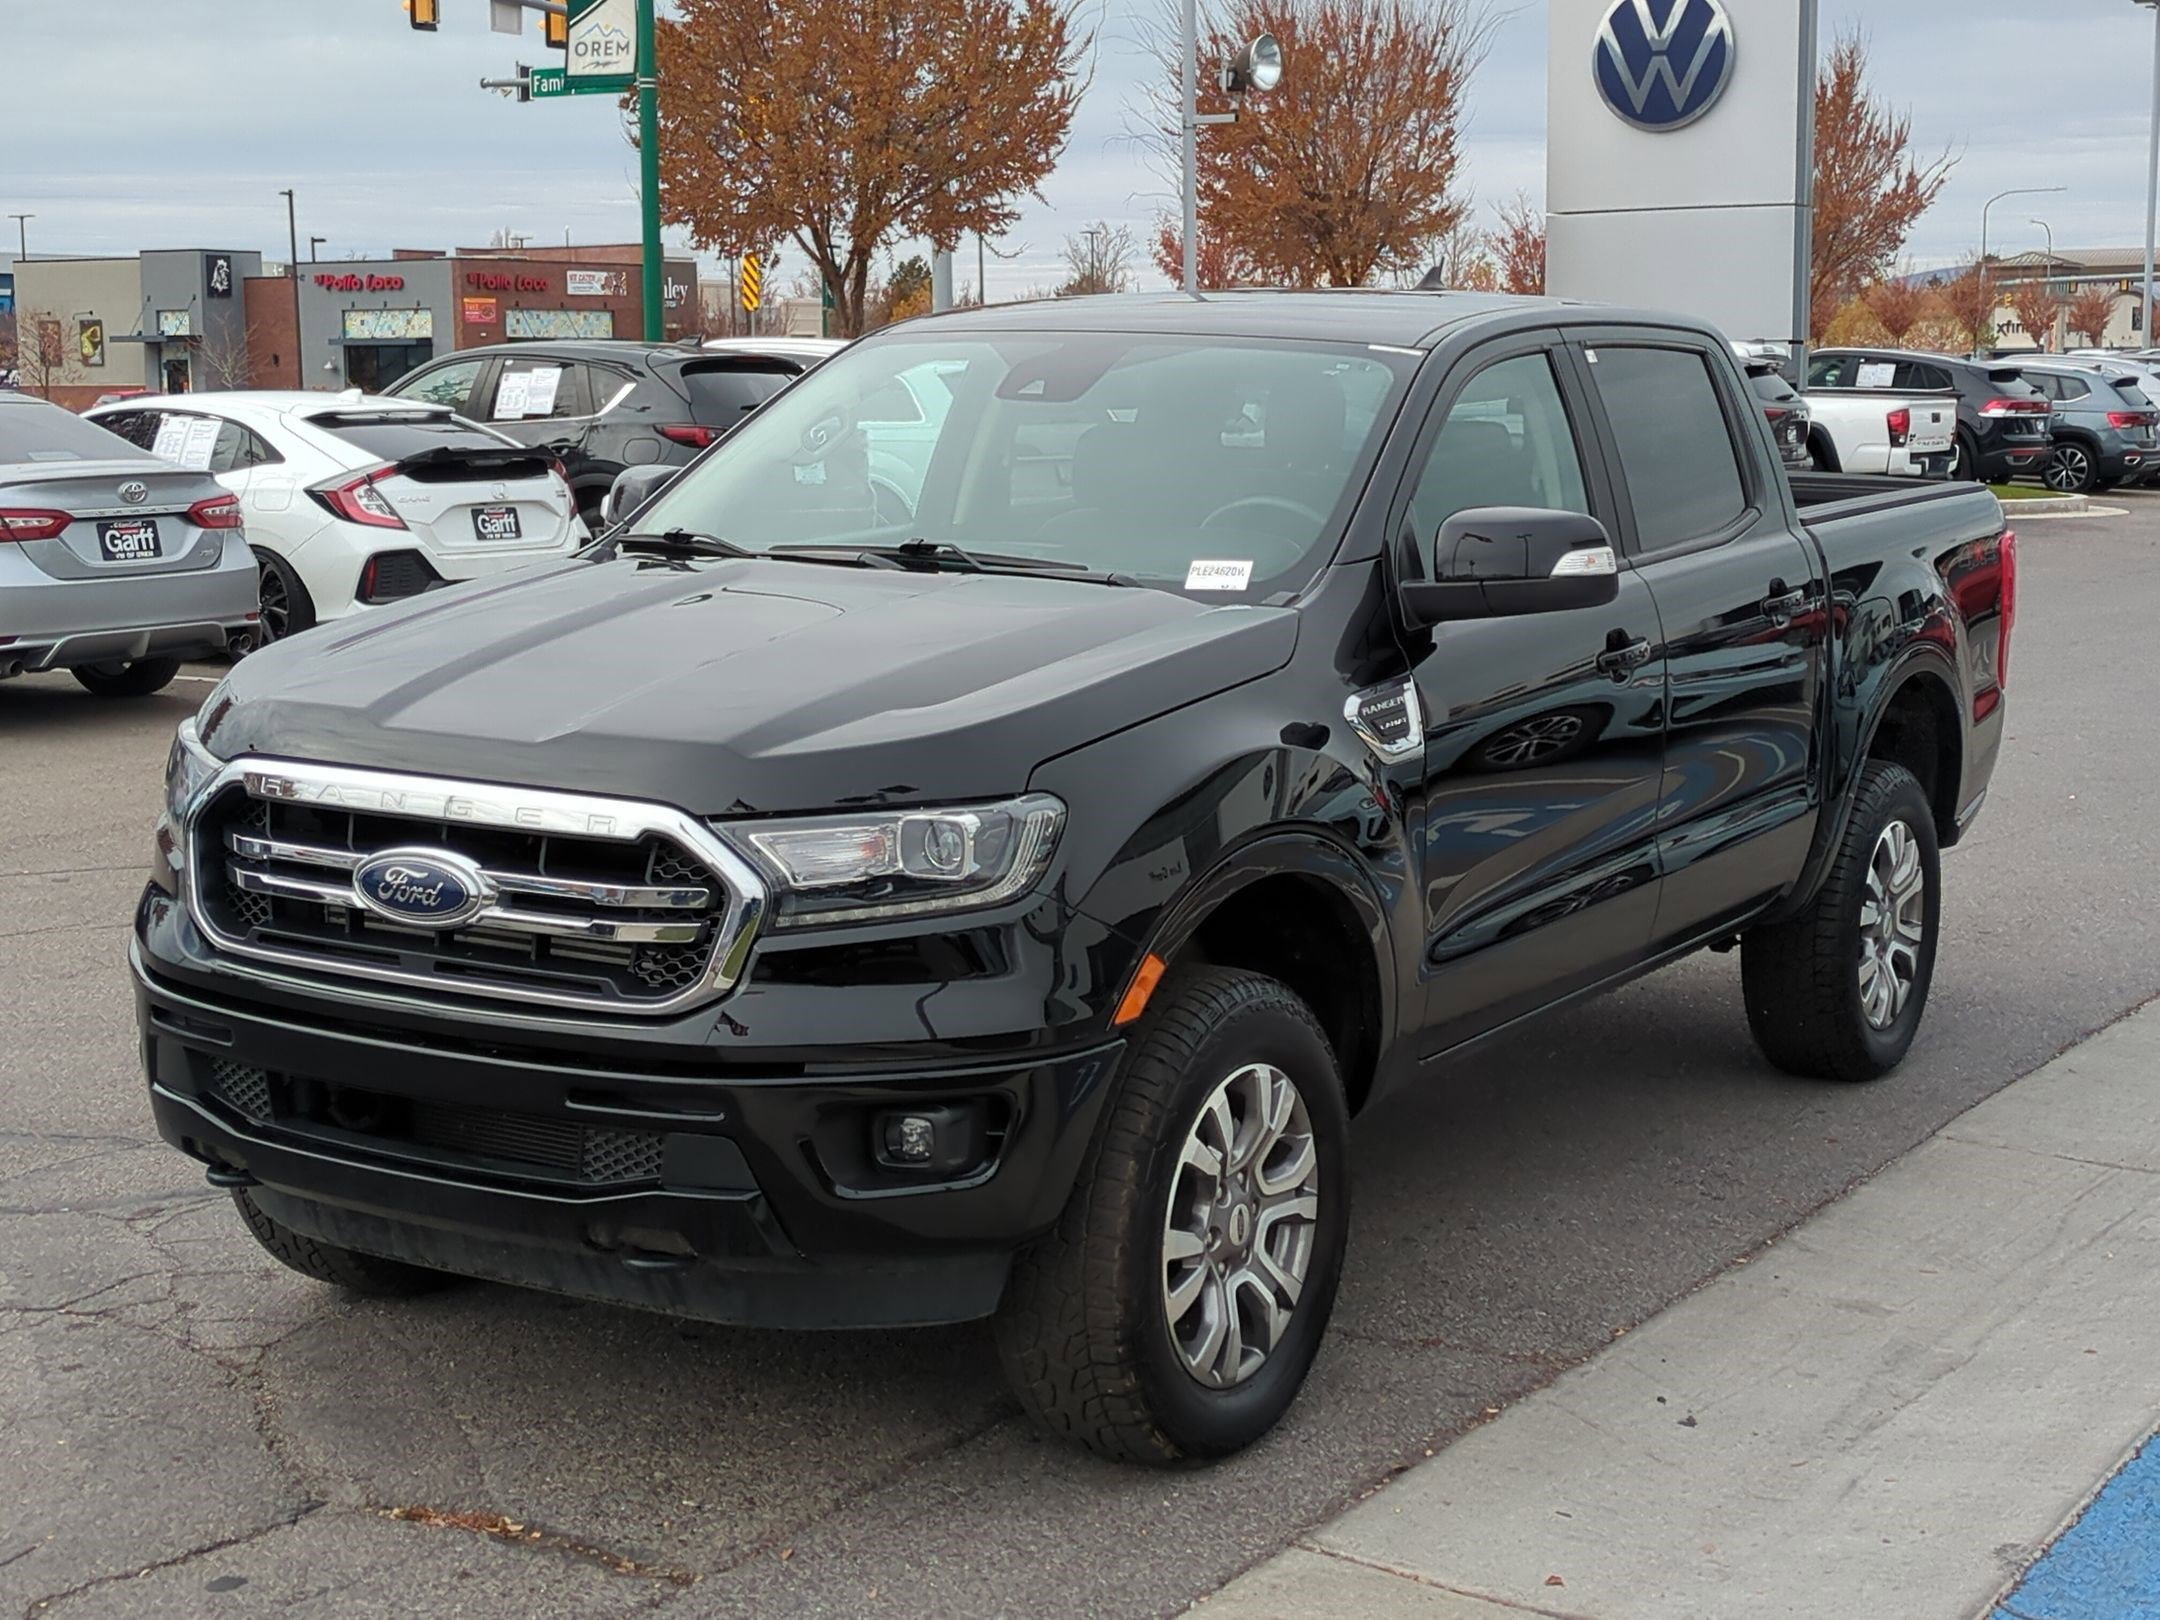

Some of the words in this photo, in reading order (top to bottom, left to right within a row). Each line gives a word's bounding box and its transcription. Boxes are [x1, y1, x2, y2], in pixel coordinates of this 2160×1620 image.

[575, 41, 630, 57] OREM
[534, 73, 566, 93] Fami
[324, 275, 361, 291] Pollo
[366, 274, 404, 292] Loco
[479, 273, 512, 290] Pollo
[516, 274, 549, 291] Loco
[1997, 320, 2024, 337] xfin
[478, 513, 516, 534] Garff
[105, 527, 154, 552] Garff
[1362, 695, 1405, 717] RANGER
[260, 776, 617, 834] RANGER
[378, 866, 443, 907] Ford
